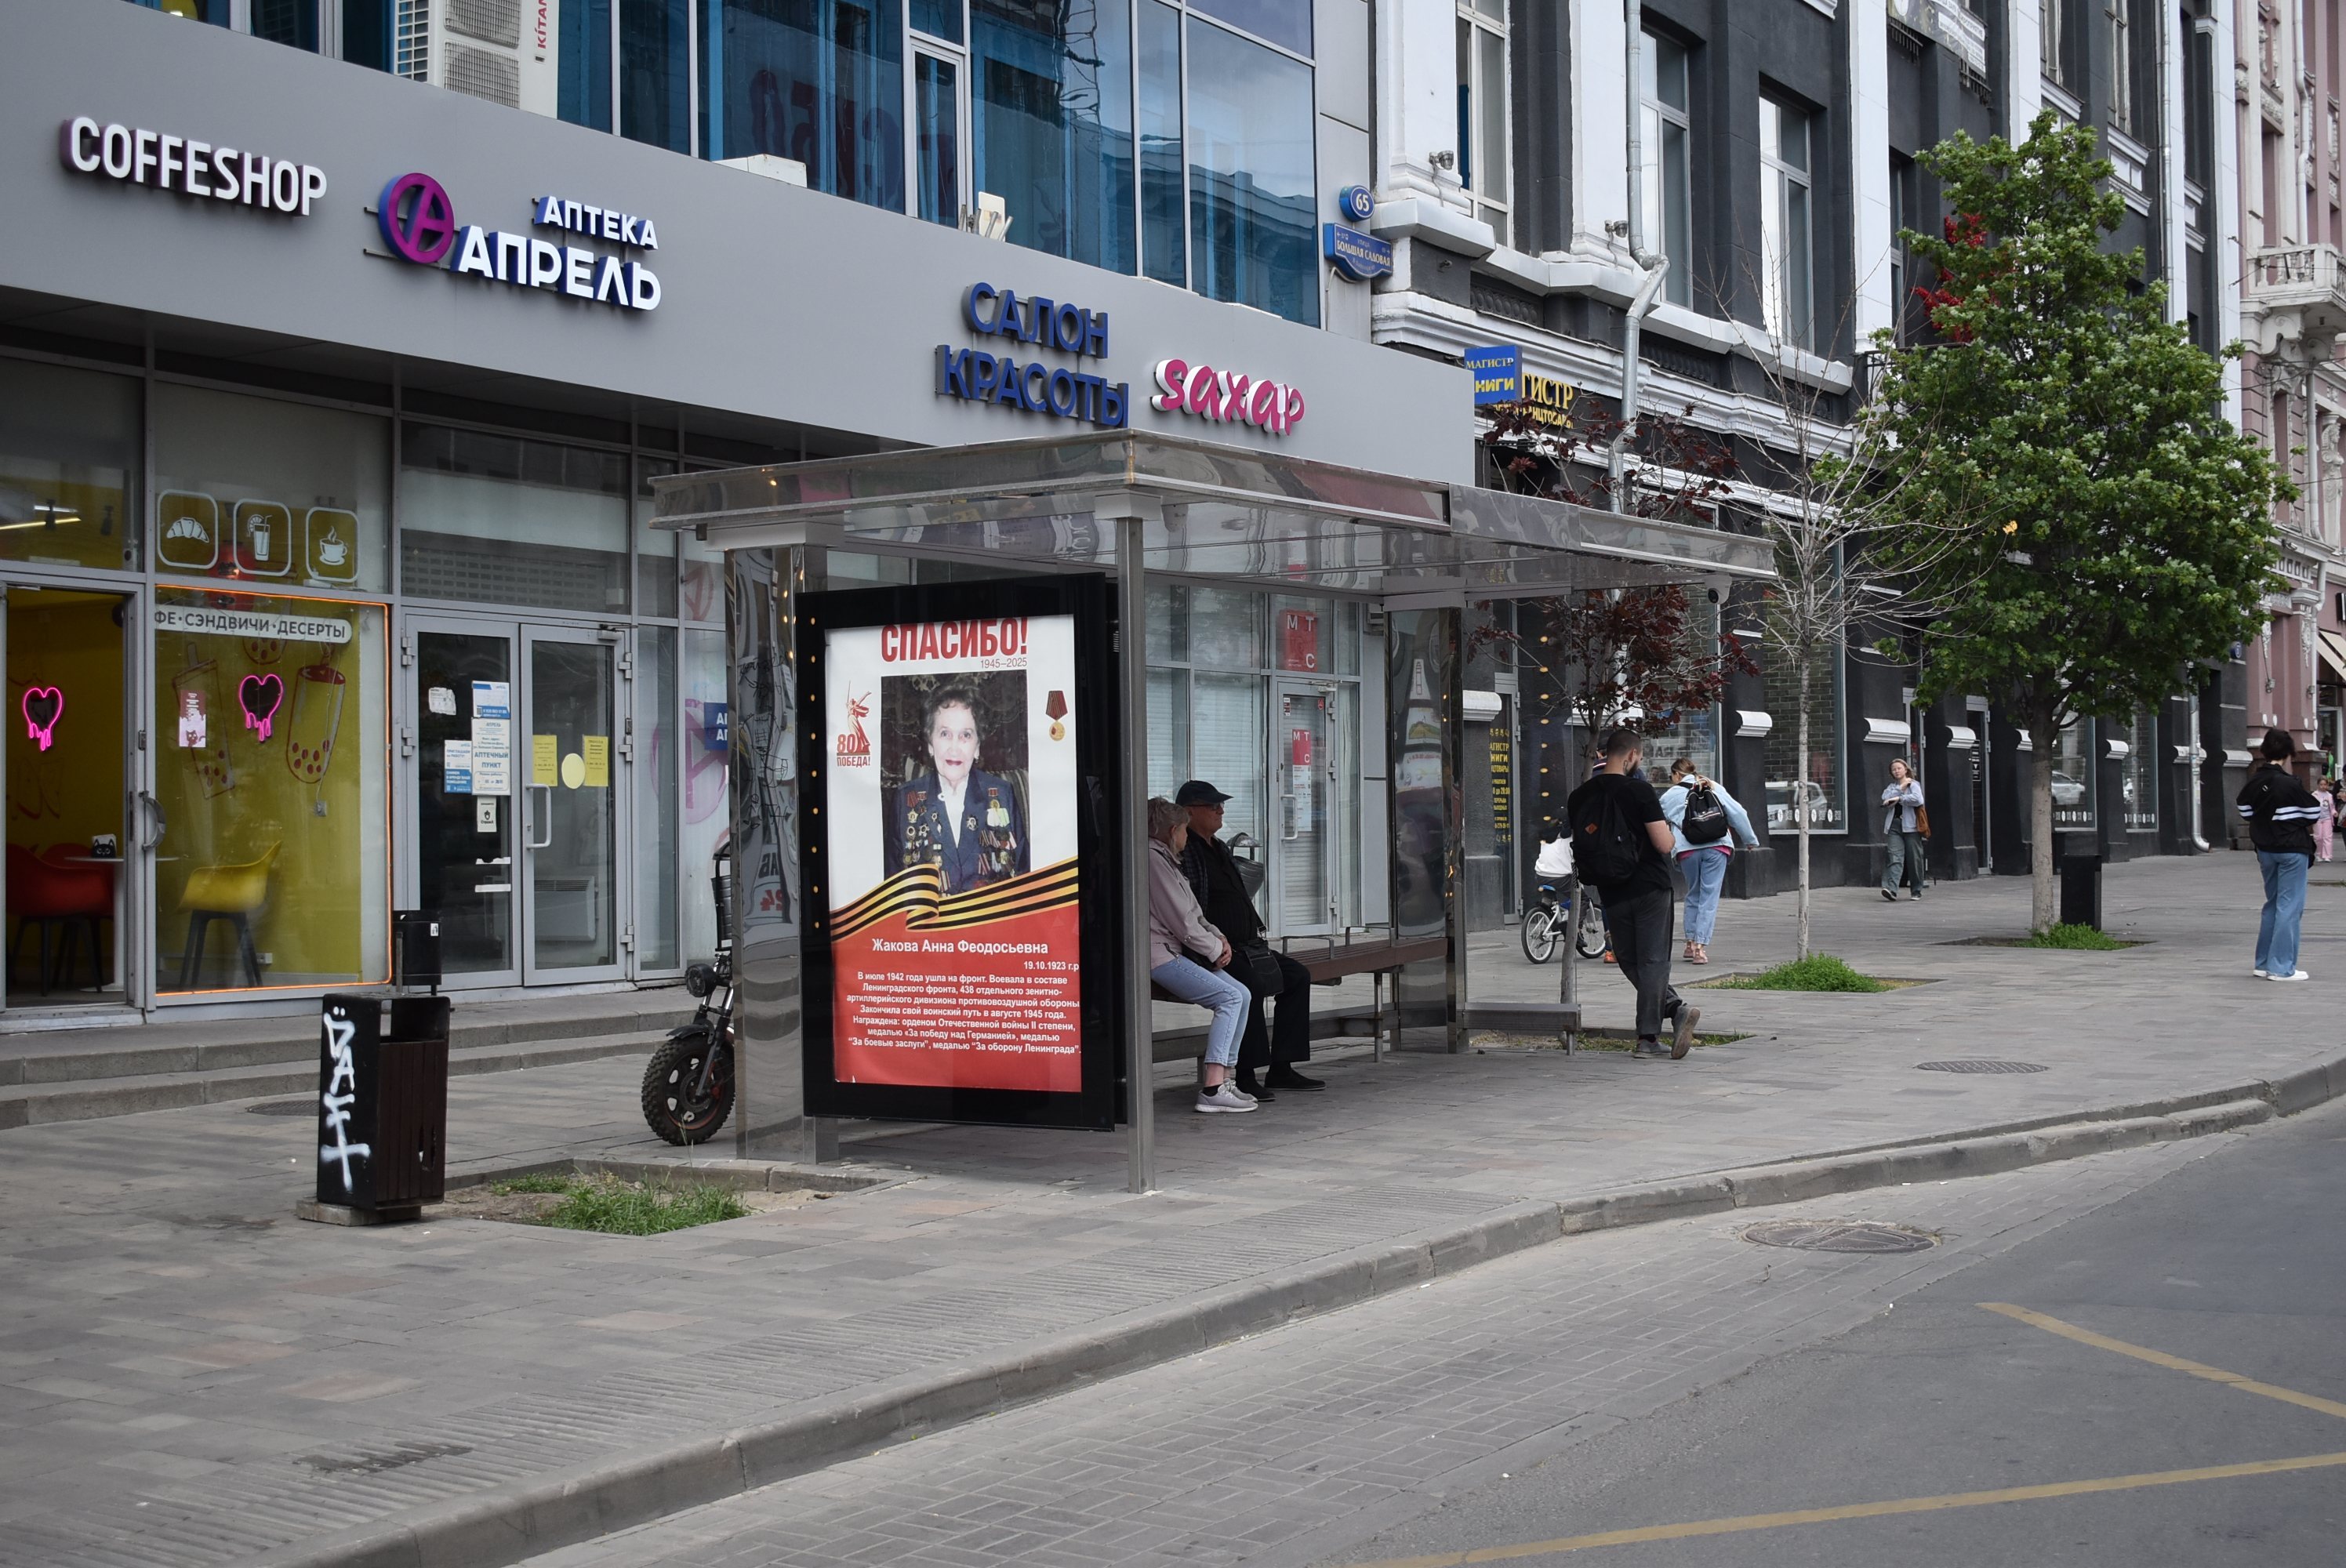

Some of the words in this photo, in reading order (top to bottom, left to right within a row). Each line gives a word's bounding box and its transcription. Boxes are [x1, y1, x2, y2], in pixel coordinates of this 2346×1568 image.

[64, 116, 327, 217] COFFESHOP
[1356, 193, 1370, 212] 65
[534, 194, 659, 250] АПТЕКА
[1337, 240, 1364, 258] БОЛЬШАЯ
[1364, 250, 1390, 267] САДОВАЯ
[451, 224, 662, 310] АПРЕЛЬ
[962, 282, 1109, 359] САЛОН
[1465, 358, 1514, 369] МАГИСТР
[935, 344, 1129, 429] КРАСОТЫ
[1475, 378, 1514, 393] НИГИ
[1521, 372, 1574, 410] ГИСТР
[154, 610, 176, 625] ФЕ
[185, 612, 269, 632] СЭНДВИЧИ
[278, 620, 346, 638] ДЕСЕРТЫ
[881, 615, 1029, 663] СПАСИБО!
[837, 734, 855, 753] 80
[1490, 742, 1509, 752] АГИСТР
[836, 755, 871, 768] ПОБЕДА!
[1491, 753, 1508, 763] НИГИ
[872, 938, 919, 953] Жакова
[921, 938, 954, 953] Анна
[957, 939, 1048, 956] Феодосьевна
[1023, 960, 1066, 971] 19.10.1923
[857, 971, 864, 980] В
[886, 972, 905, 982] 1942
[906, 975, 924, 983] года
[924, 975, 946, 984] ушла
[959, 974, 987, 985] фронт.
[989, 974, 1025, 984] Воевала
[862, 982, 924, 994] Ленинградского
[925, 984, 958, 995] фронта,
[960, 985, 975, 994] 438
[975, 987, 1024, 996] отдельного
[1025, 988, 1062, 996] зенитно-
[846, 994, 913, 1004] артиллерийского
[913, 996, 957, 1005] дивизиона
[958, 998, 1038, 1008] противовоздушной
[859, 1004, 901, 1014] Закончила
[902, 1006, 921, 1014] свой
[923, 1007, 961, 1016] воинский
[962, 1009, 982, 1018] путь
[990, 1010, 1022, 1019] августе
[1023, 1009, 1043, 1018] 1945
[1044, 1011, 1067, 1020] года.
[852, 1015, 900, 1026] Награждена:
[902, 1018, 937, 1028] орденом
[938, 1018, 1000, 1029] Отечественной
[1001, 1020, 1030, 1029] войны
[1031, 1021, 1037, 1029] II
[1038, 1022, 1076, 1032] степени,
[920, 1029, 949, 1040] победу
[950, 1031, 966, 1040] над
[1020, 1033, 1060, 1042] медалью
[863, 1037, 894, 1047] боевые
[932, 1042, 971, 1051] медалью
[987, 1042, 1023, 1053] оборону
